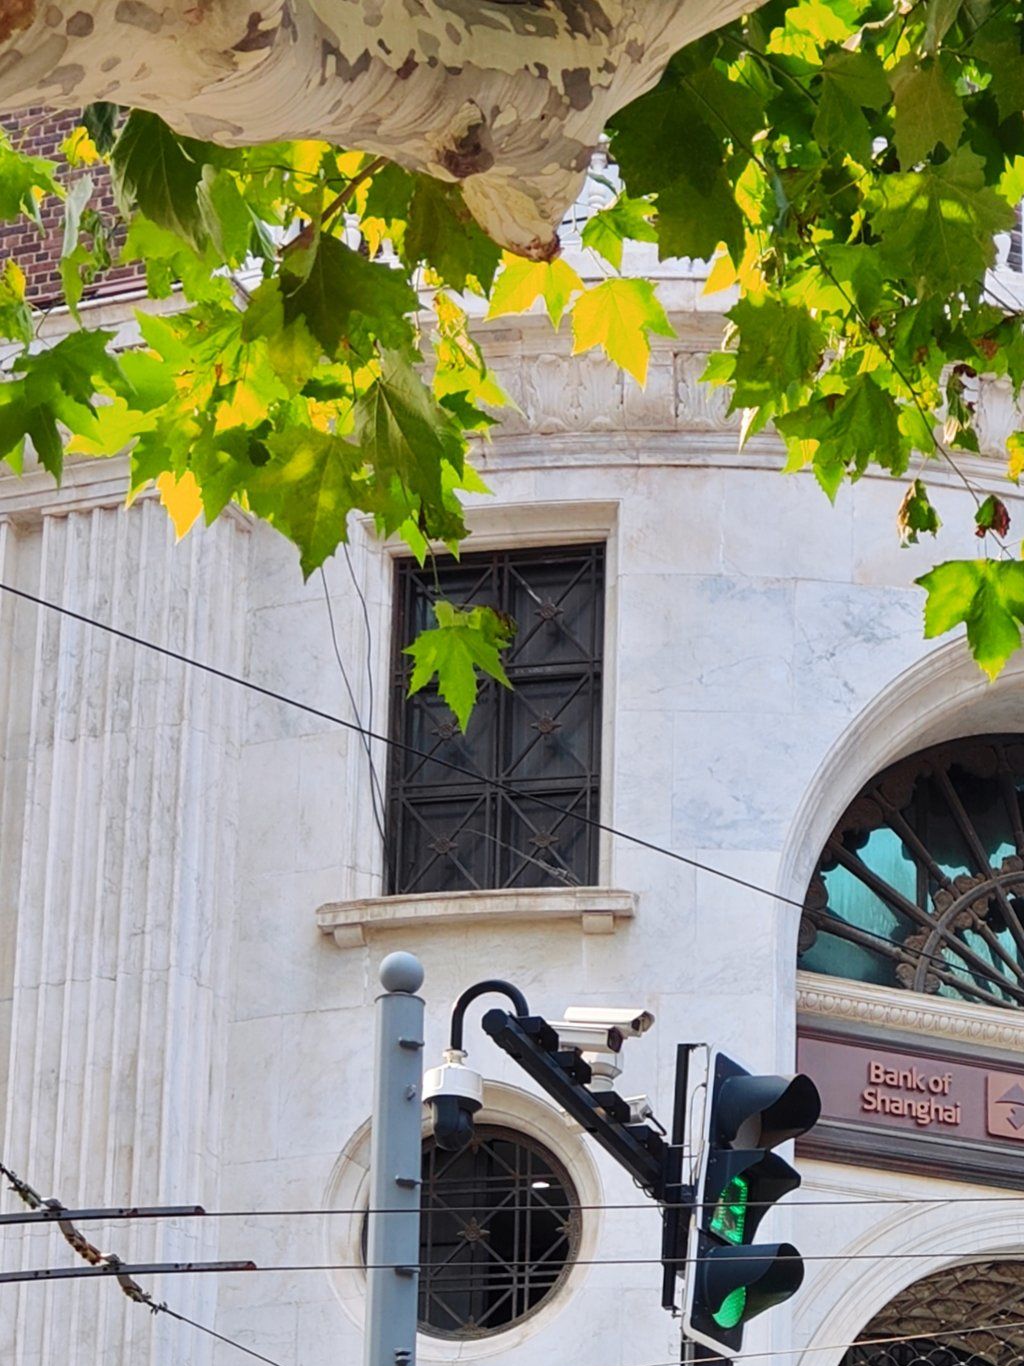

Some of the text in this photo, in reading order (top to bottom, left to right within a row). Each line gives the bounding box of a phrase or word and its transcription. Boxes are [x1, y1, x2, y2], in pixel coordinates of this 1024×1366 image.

[869, 1061, 953, 1096] Bank of
[862, 1087, 961, 1126] Shanghai
